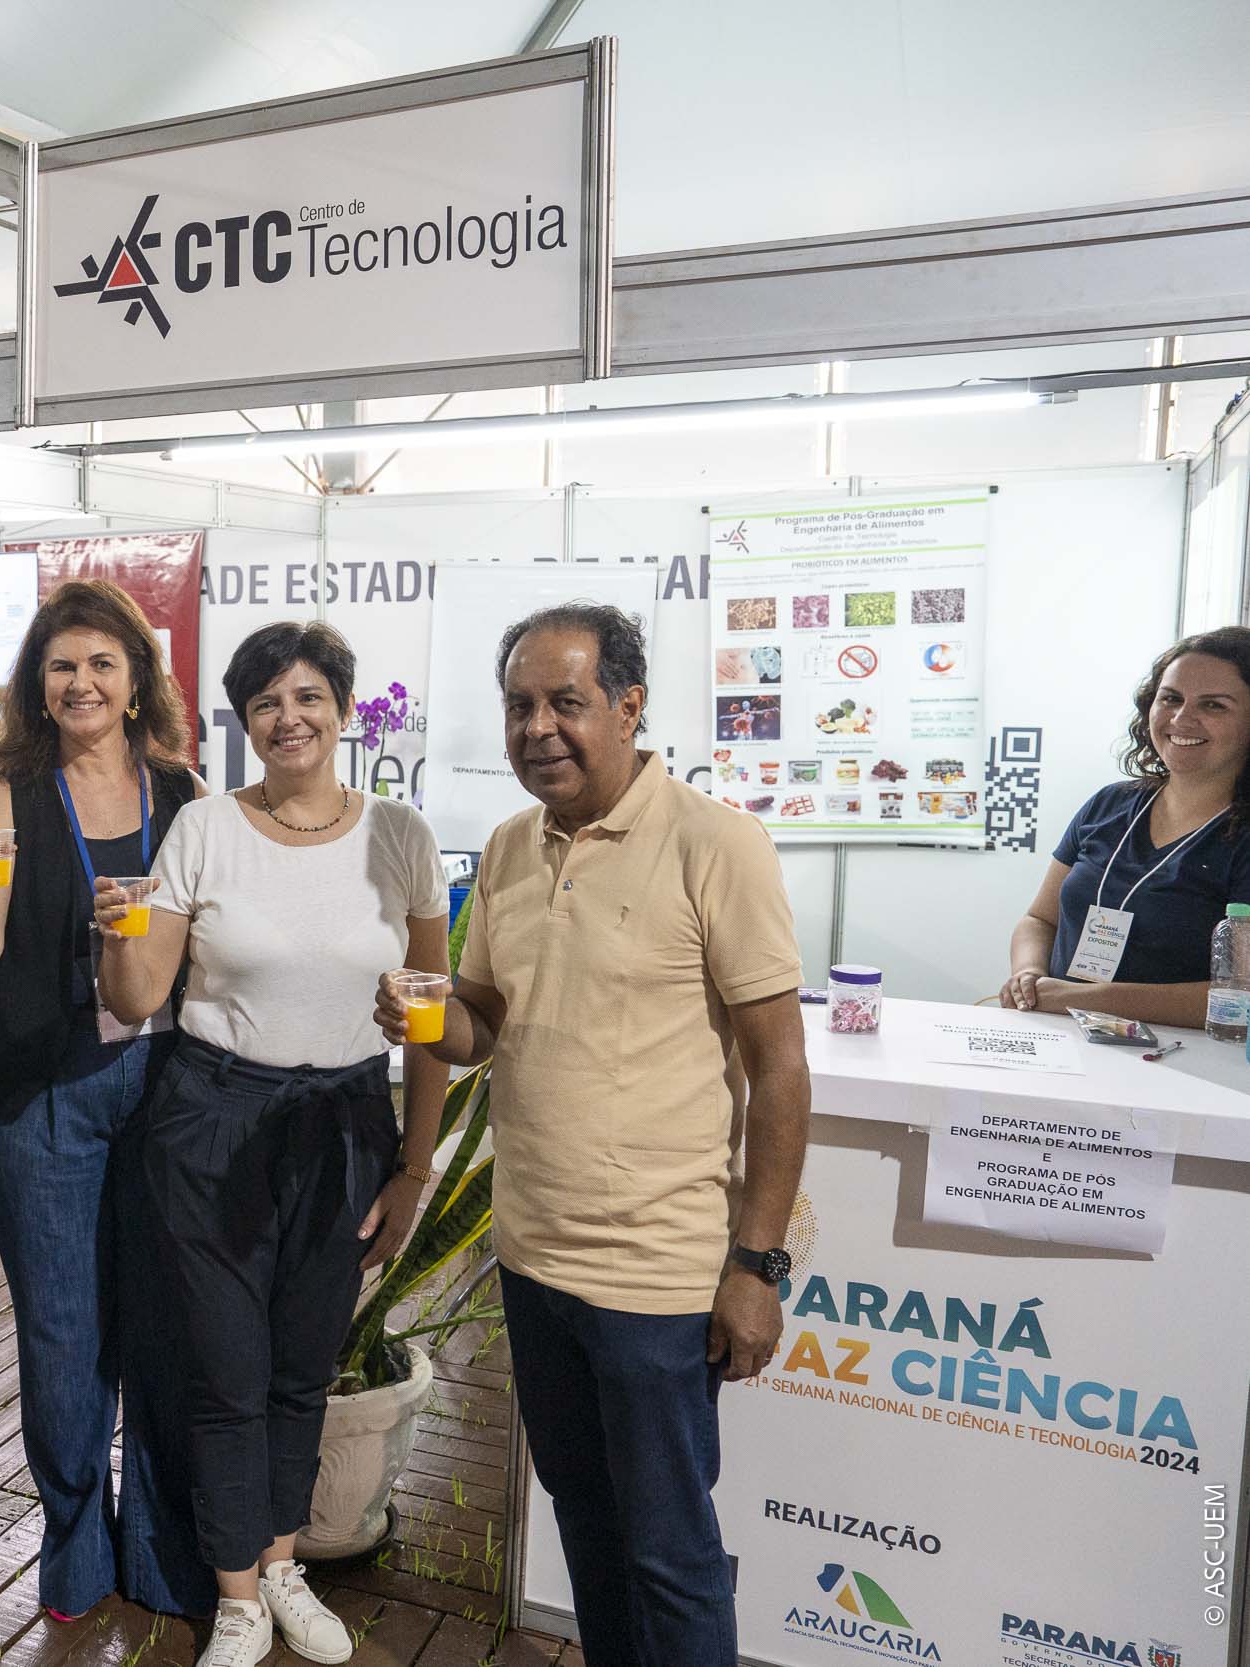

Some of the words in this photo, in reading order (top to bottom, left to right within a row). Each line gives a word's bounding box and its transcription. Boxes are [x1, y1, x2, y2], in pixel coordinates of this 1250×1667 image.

[299, 204, 343, 222] Centro
[348, 199, 366, 217] de
[175, 210, 292, 294] CTC
[298, 195, 567, 278] Tecnologia
[774, 516, 824, 526] Programa
[827, 513, 840, 522] de
[843, 510, 924, 521] Pós-Graduação
[793, 524, 852, 534] Engenharia
[854, 522, 868, 530] de
[870, 518, 924, 529] Alimentos
[452, 766, 506, 777] DEPARTAMENTO
[982, 1115, 1097, 1138] DEPARTAMENTO
[1102, 1130, 1122, 1141] DE
[950, 1126, 1041, 1146] ENGENHARIA
[1045, 1138, 1065, 1148] DE
[1068, 1140, 1152, 1159] ALIMENTOS
[1042, 1152, 1052, 1162] E
[978, 1161, 1058, 1180] PROGRAMA
[1063, 1171, 1082, 1182] DE
[1086, 1173, 1116, 1187] PÓS
[987, 1176, 1078, 1197] GRADUAÇÃO
[1082, 1188, 1103, 1200] EM
[945, 1186, 1036, 1206] ENGENHARIA
[1040, 1198, 1058, 1208] DE
[1062, 1200, 1146, 1220] ALIMENTOS
[891, 1348, 1199, 1450] CIÊNCIA
[772, 1378, 835, 1403] SEMANA
[839, 1390, 918, 1418] NACIONAL
[922, 1406, 942, 1424] DE
[946, 1410, 1010, 1436] CIÊNCIA
[1014, 1424, 1025, 1439] E
[1028, 1426, 1137, 1462] TECNOLOGIA
[1140, 1446, 1200, 1475] 2024
[763, 1498, 942, 1555] REALIZAÇÃO
[1000, 1637, 1074, 1660] GOVERNO
[1002, 1612, 1142, 1667] PARANÁ
